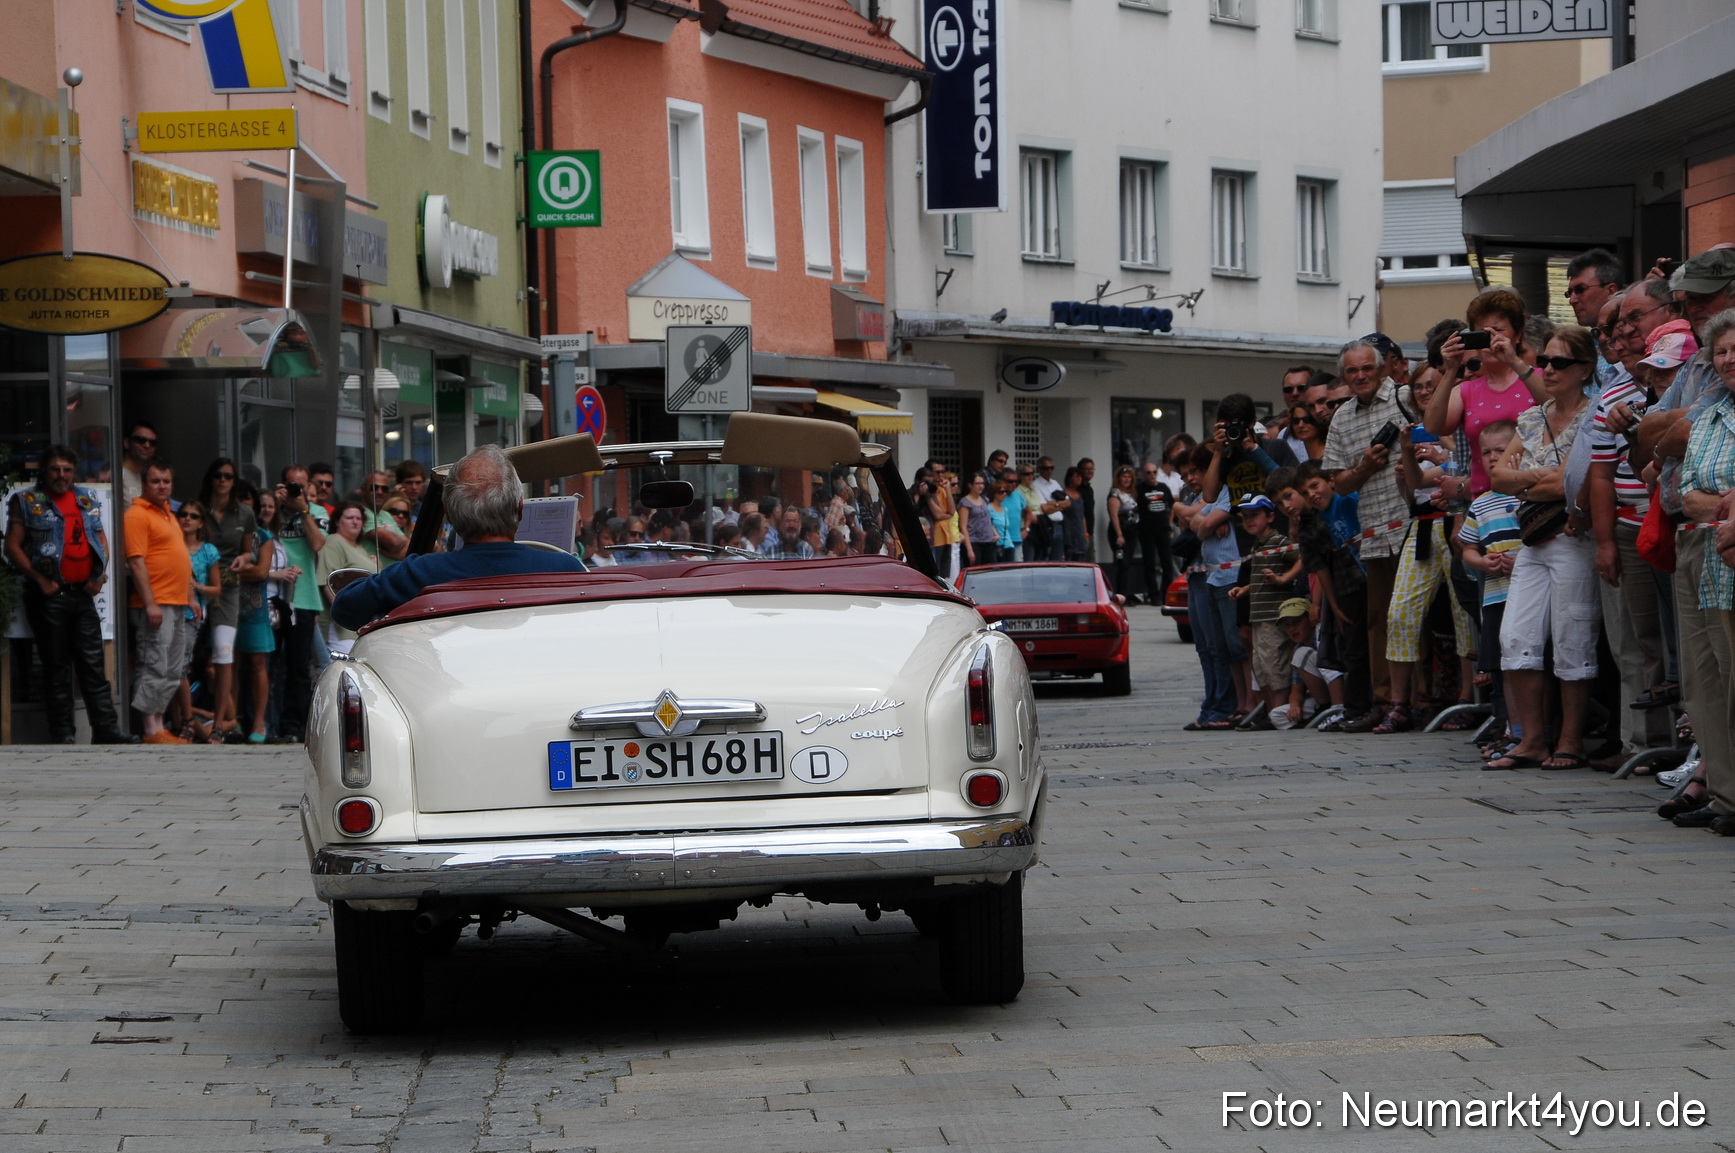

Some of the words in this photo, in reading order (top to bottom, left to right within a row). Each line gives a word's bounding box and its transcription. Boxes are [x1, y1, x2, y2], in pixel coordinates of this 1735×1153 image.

[1437, 0, 1608, 39] WEIDEN
[146, 121, 270, 139] KLOSTERGASSE
[278, 121, 287, 136] 4
[973, 62, 992, 180] TOM
[537, 213, 563, 222] QUICK
[565, 213, 595, 221] SCHUH
[14, 286, 163, 302] GOLDSCHMIEDE
[28, 310, 62, 320] JUTTA
[66, 309, 110, 319] ROTHER
[653, 299, 729, 325] Creppresso
[688, 390, 729, 405] ZONE
[796, 698, 905, 735] Isabella
[850, 726, 904, 742] coupé
[574, 745, 620, 783] EI
[809, 750, 831, 780] D
[557, 771, 566, 782] D
